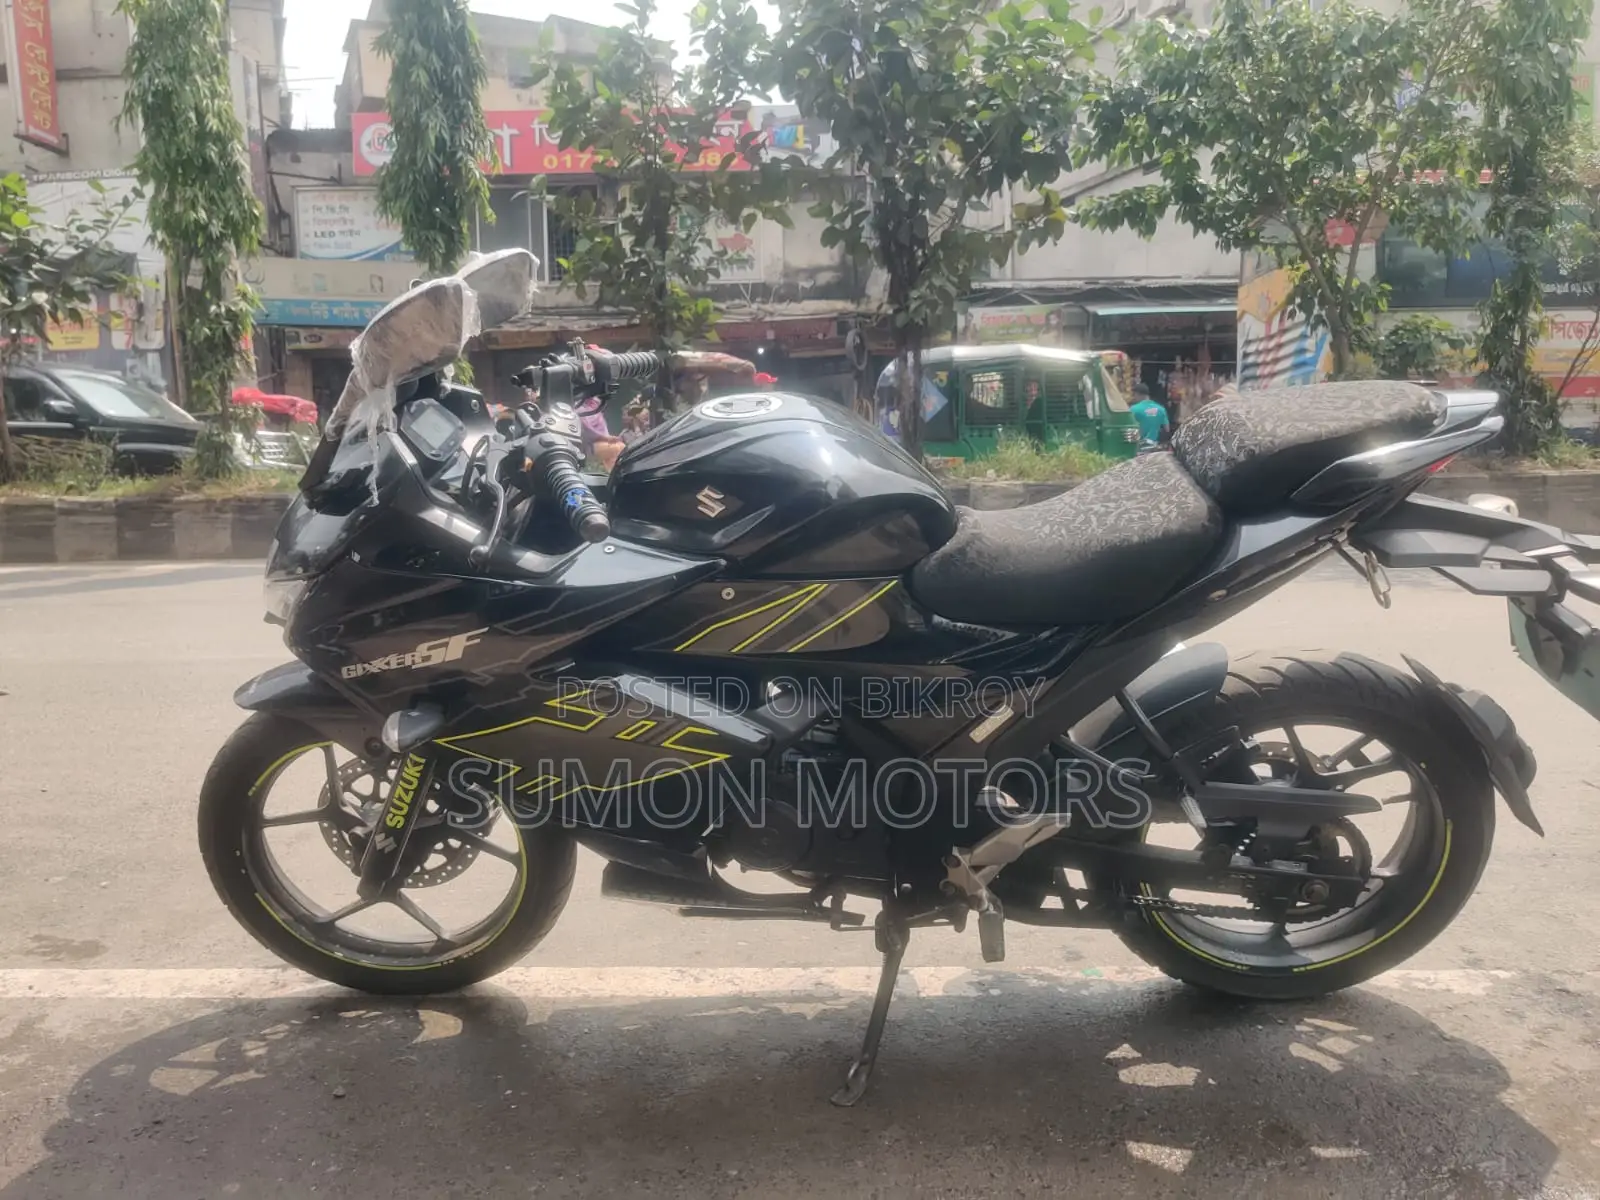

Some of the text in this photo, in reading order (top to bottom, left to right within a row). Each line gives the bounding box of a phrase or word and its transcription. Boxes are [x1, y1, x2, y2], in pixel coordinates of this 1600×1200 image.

[32, 170, 101, 183] TRANSCOM
[314, 230, 336, 239] LED
[386, 753, 427, 829] SUZUKI
